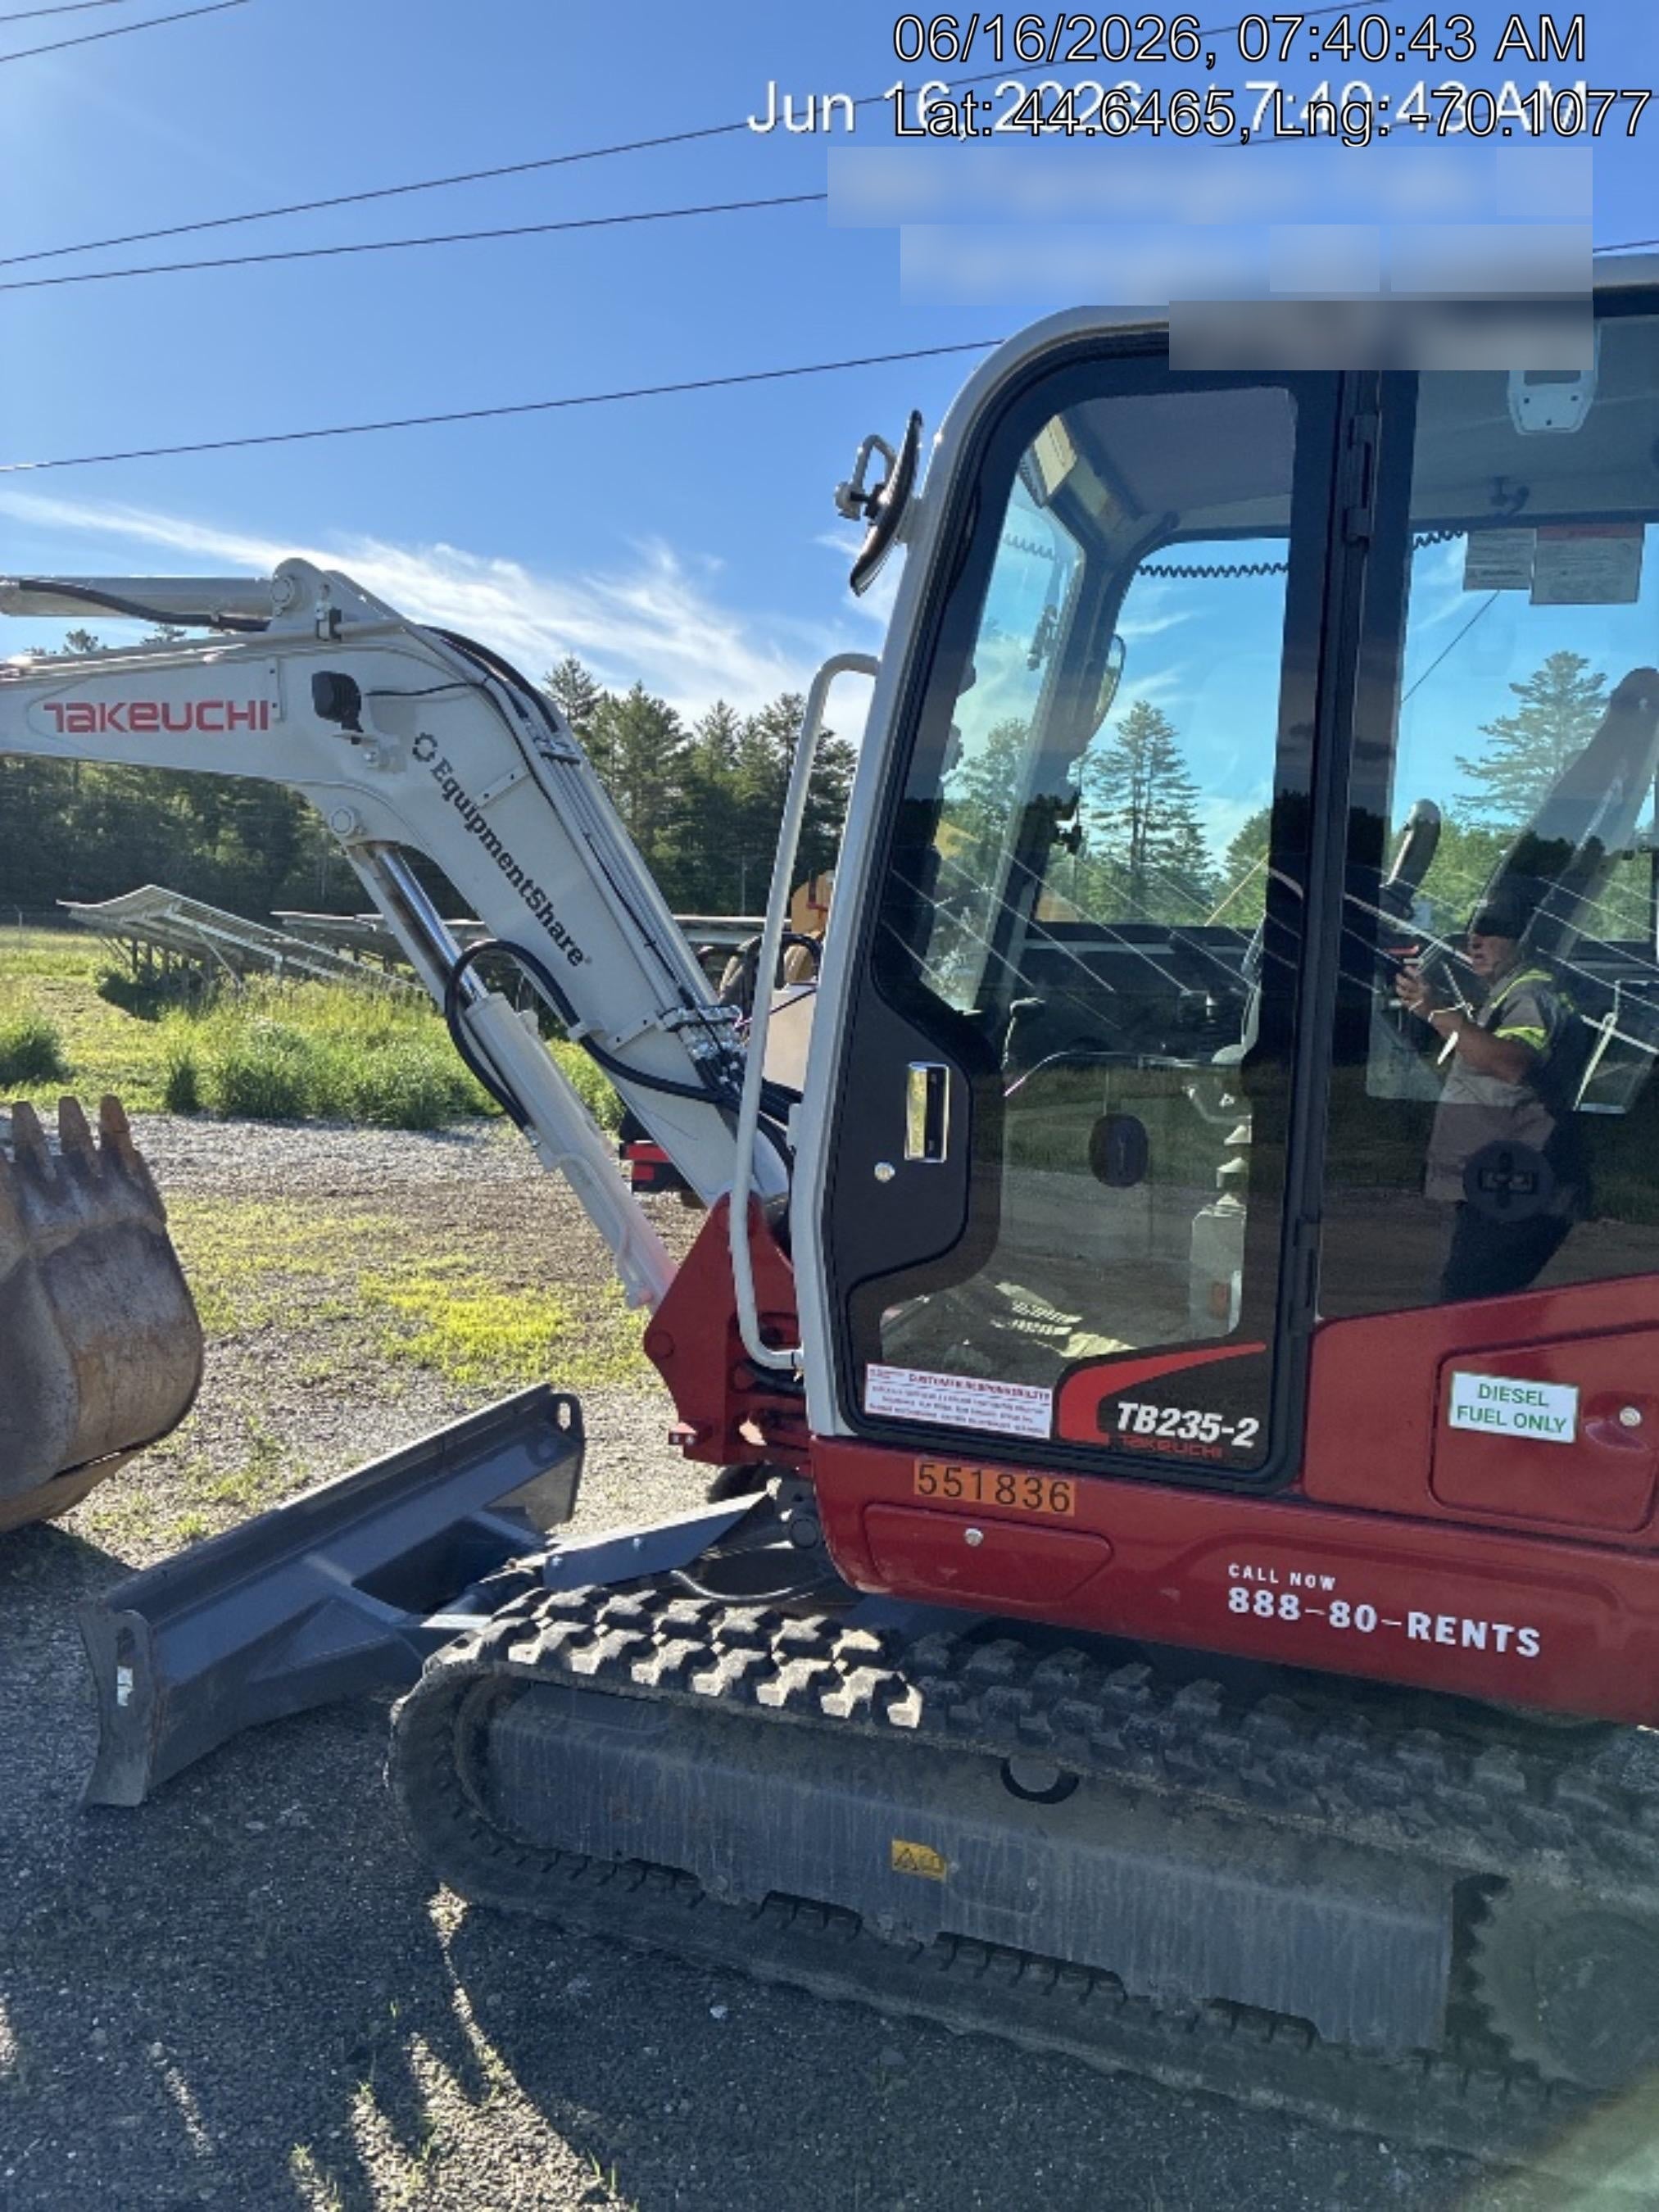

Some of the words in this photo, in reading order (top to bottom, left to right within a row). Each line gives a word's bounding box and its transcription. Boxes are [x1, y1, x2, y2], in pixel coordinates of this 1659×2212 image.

[1478, 1384, 1549, 1407] DIESEL
[1117, 1402, 1260, 1448] TB235-2
[1457, 1405, 1507, 1426] FUEL
[1514, 1412, 1566, 1434] ONLY
[918, 1464, 1070, 1512] 551836
[1228, 1562, 1279, 1584] CALL
[1290, 1571, 1336, 1591] NOW
[1228, 1586, 1540, 1657] 888-80-RENTS
